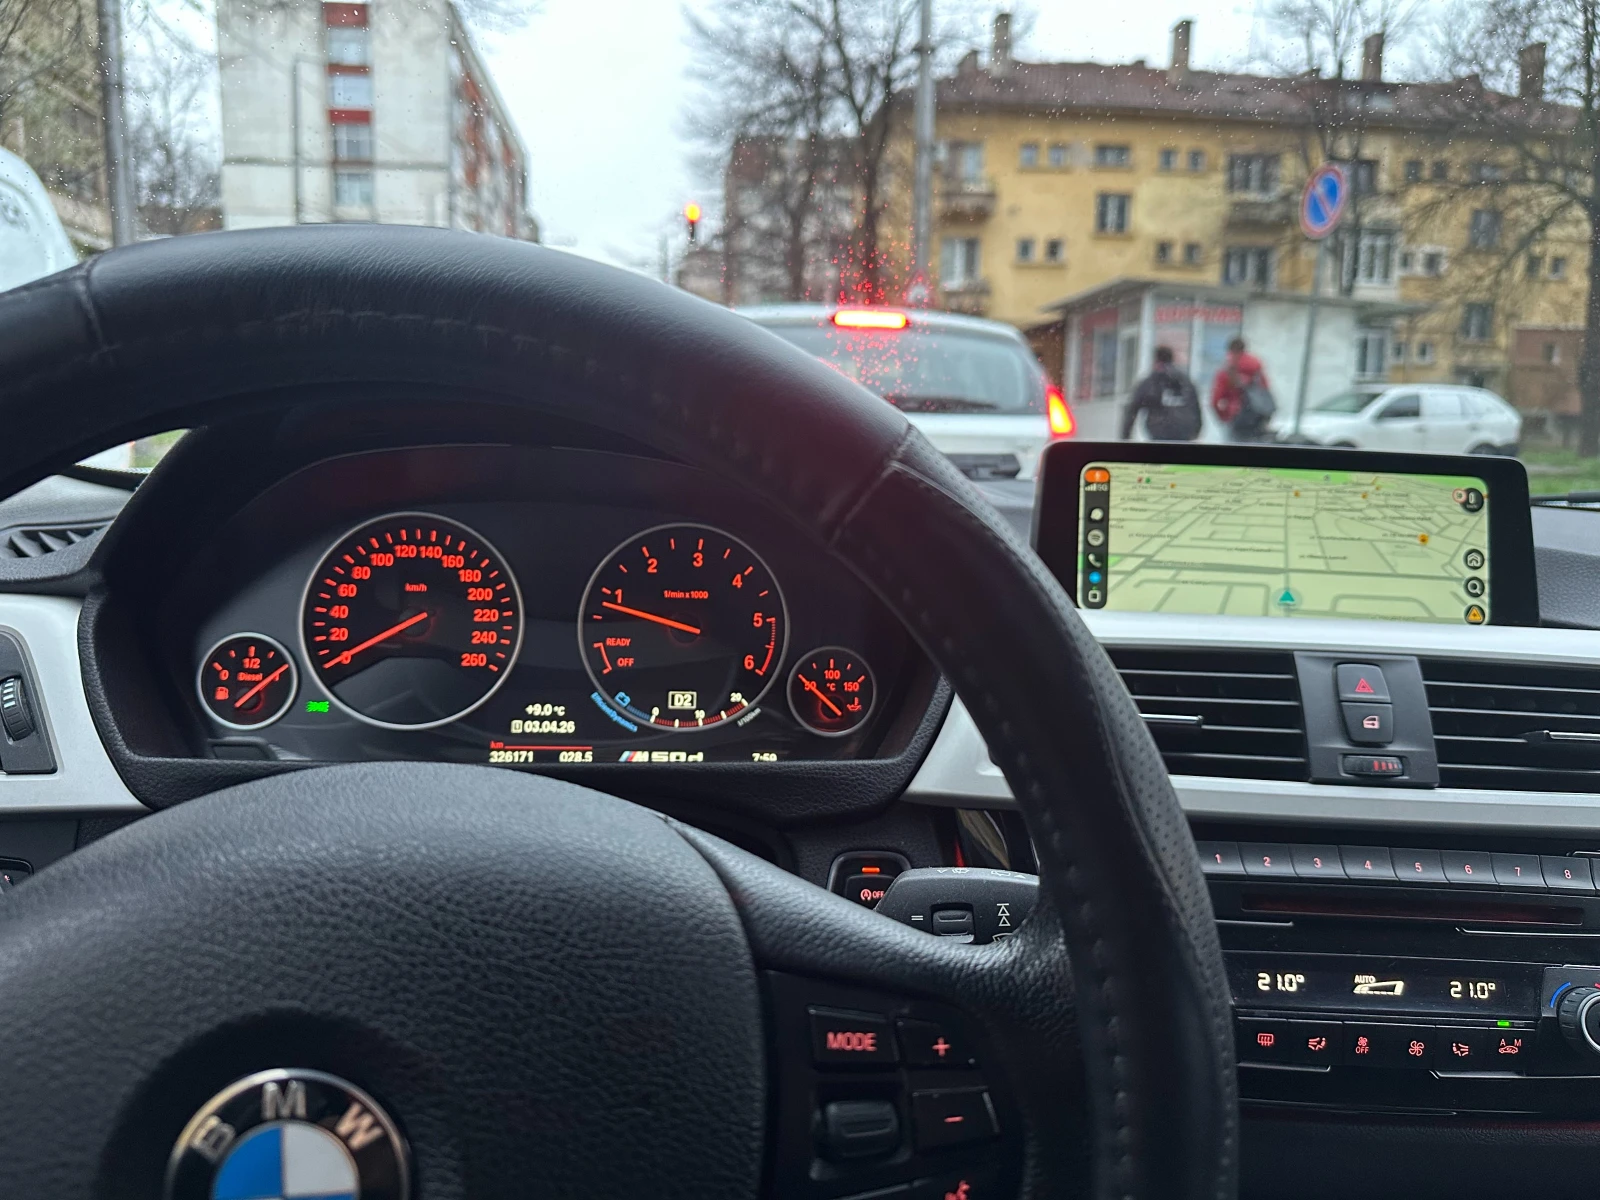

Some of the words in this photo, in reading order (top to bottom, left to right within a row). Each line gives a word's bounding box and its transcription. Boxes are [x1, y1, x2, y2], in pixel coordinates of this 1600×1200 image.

[394, 545, 417, 558] 120
[419, 545, 442, 559] 140
[370, 553, 393, 567] 100
[441, 554, 464, 568] 160
[647, 558, 658, 573] 2
[692, 552, 704, 567] 3
[351, 566, 370, 580] 80
[458, 569, 482, 583] 180
[404, 582, 428, 593] km/h
[732, 574, 743, 588] 4
[337, 584, 357, 598] 60
[467, 587, 493, 601] 200
[614, 589, 623, 603] 1
[663, 590, 685, 598] 1/min
[690, 590, 709, 599] 1000
[329, 605, 349, 619] 40
[473, 608, 499, 622] 220
[753, 612, 763, 627] 5
[329, 627, 349, 641] 20
[471, 631, 497, 644] 240
[606, 637, 631, 646] READY
[242, 657, 261, 669] 1/2
[461, 653, 487, 667] 260
[617, 658, 634, 667] OFF
[744, 655, 754, 669] 6
[219, 669, 229, 681] 0
[824, 669, 841, 680] 100
[843, 682, 860, 692] 150
[673, 694, 692, 706] D2
[730, 692, 742, 702] 20
[525, 703, 553, 716] +9.0
[695, 710, 705, 718] 10
[523, 720, 576, 733] 03.04.26
[490, 741, 504, 749] km
[489, 750, 534, 763] 326171
[559, 751, 593, 763] 028.5
[1215, 852, 1222, 864] 1
[1263, 856, 1271, 868] 2
[1313, 857, 1322, 869] 3
[1364, 860, 1372, 871] 4
[1414, 861, 1423, 873] 5
[1464, 864, 1472, 875] 6
[1514, 867, 1521, 878] 7
[1563, 869, 1572, 880] 8
[1354, 974, 1375, 984] AUTO
[827, 1031, 877, 1052] MODE
[1499, 1038, 1506, 1047] A
[1514, 1039, 1522, 1047] M
[1355, 1045, 1369, 1055] OFF
[190, 1079, 384, 1164] BMW
